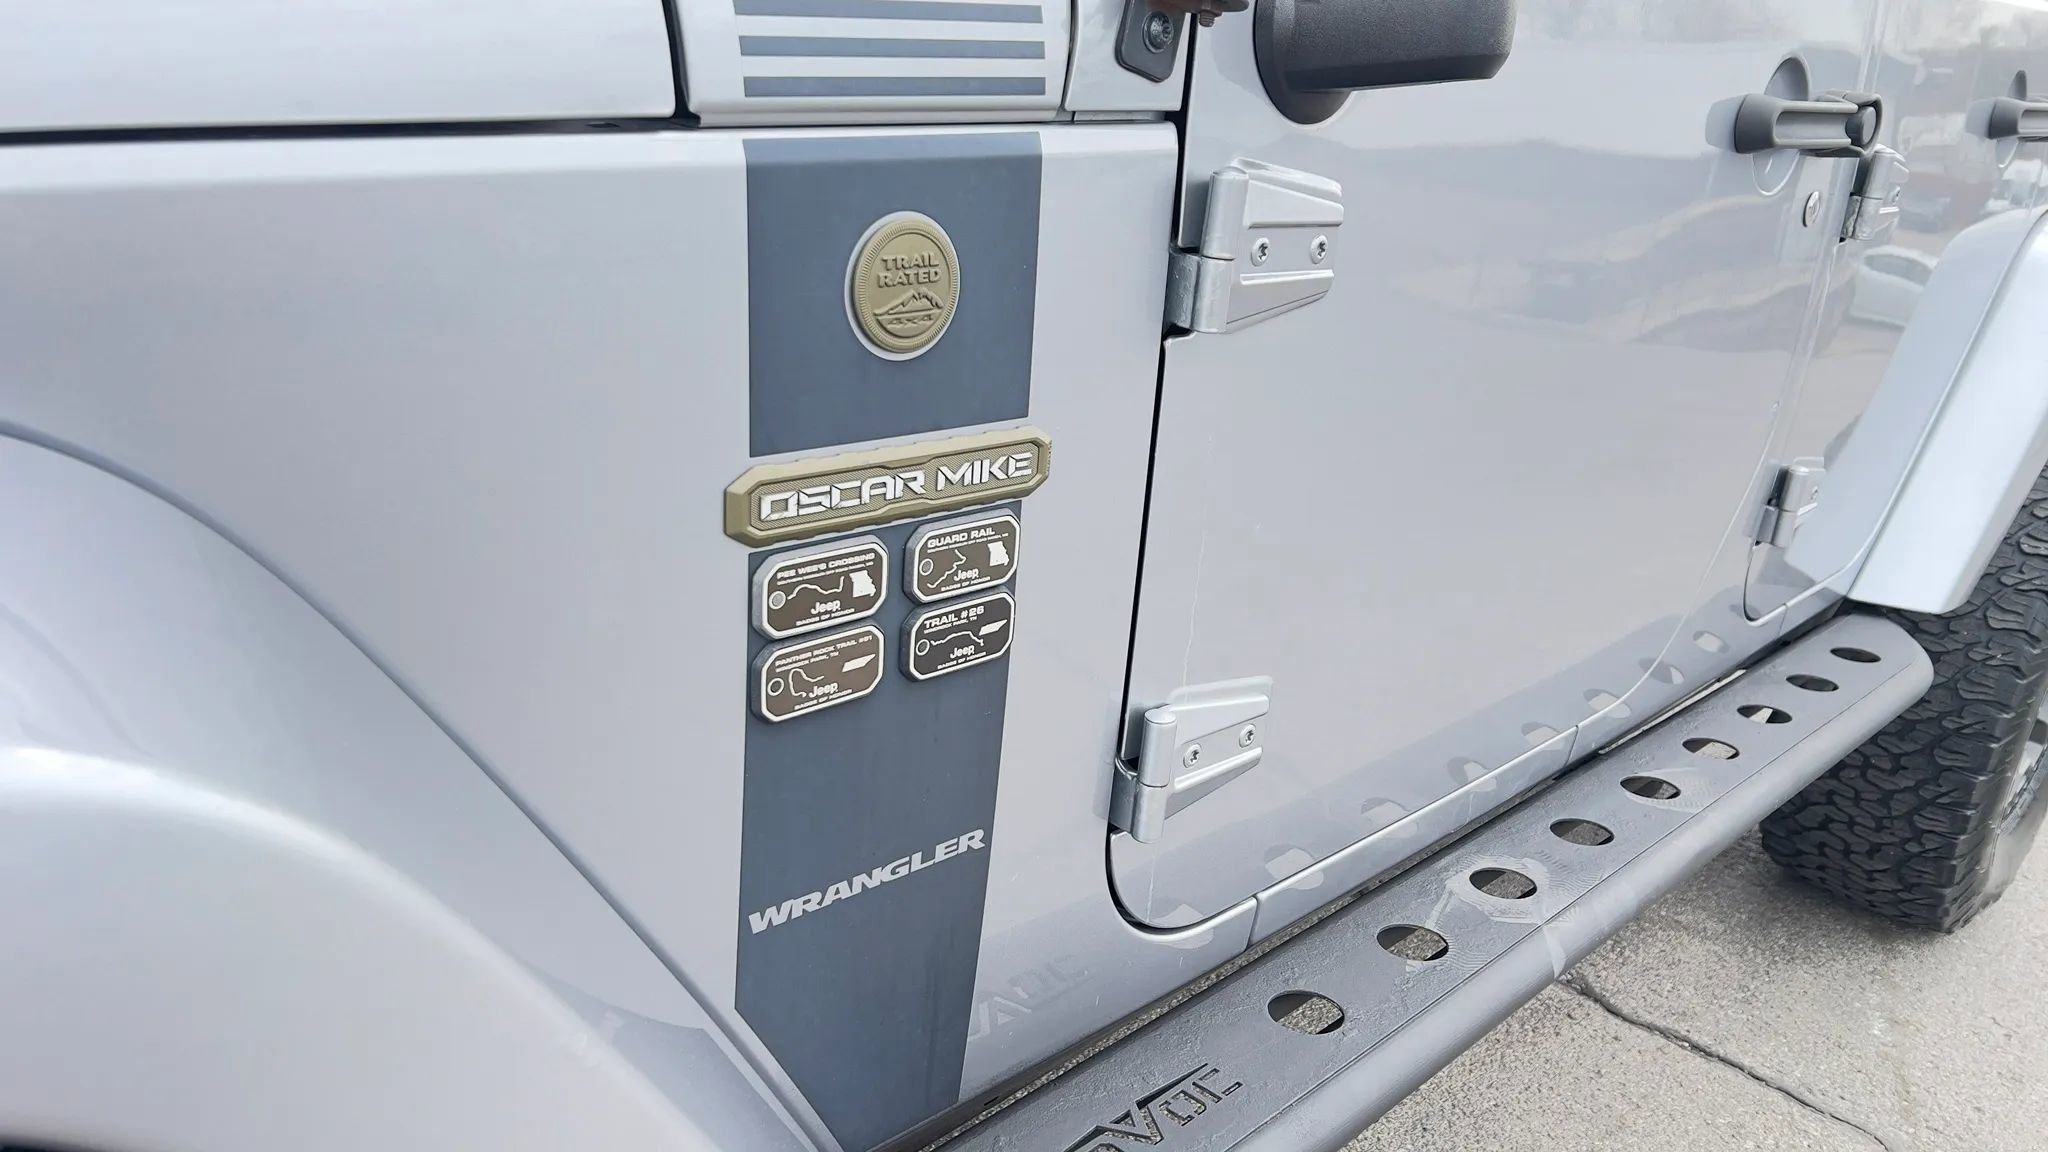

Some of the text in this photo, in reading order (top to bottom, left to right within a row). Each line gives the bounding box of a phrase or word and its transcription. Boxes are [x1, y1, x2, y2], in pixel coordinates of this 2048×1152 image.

[881, 251, 940, 271] TRAIL
[877, 268, 941, 288] RATED
[759, 451, 1033, 522] OSCAR MIKE
[927, 532, 968, 548] GUARD
[971, 527, 995, 539] RAIL
[776, 569, 796, 579] PEE
[828, 552, 875, 568] CROSSING
[954, 568, 979, 582] Jeep
[810, 600, 841, 614] Jeep
[924, 605, 985, 629] TRAIL #26
[775, 652, 812, 667] PANTHER
[813, 645, 835, 656] ROCK
[836, 640, 857, 650] TRAIL
[950, 645, 975, 659] Jeep
[808, 682, 838, 698] Jeep
[748, 828, 986, 935] WRANGLER
